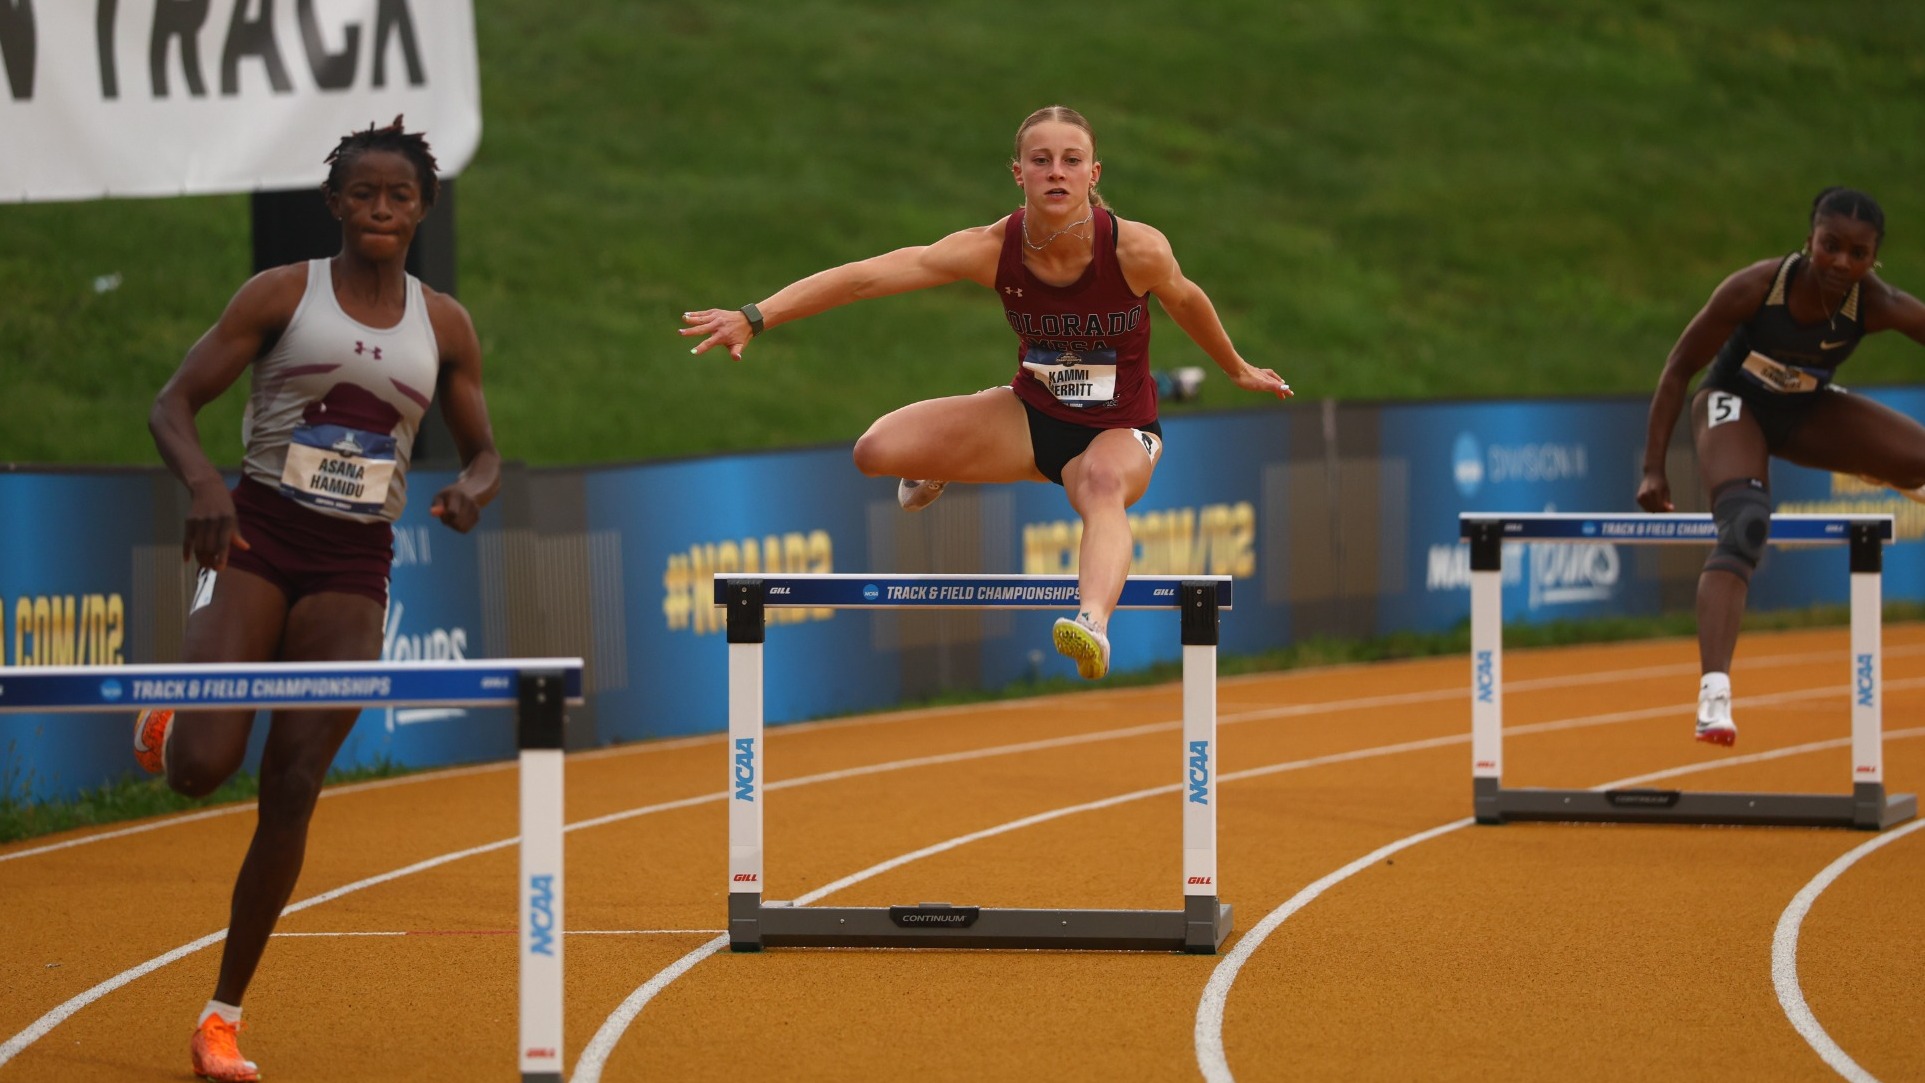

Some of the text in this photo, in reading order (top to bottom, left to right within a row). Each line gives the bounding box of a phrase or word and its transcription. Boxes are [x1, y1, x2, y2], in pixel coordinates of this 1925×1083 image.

[1048, 369, 1089, 383] KAMMI
[1715, 396, 1733, 422] 5
[318, 458, 365, 480] ASANA
[310, 474, 365, 498] HAMIDU
[769, 587, 791, 595] GILL
[887, 586, 1081, 600] TRACK & FIELD CHAMPIONSHIPS
[1153, 588, 1175, 596] GILL
[132, 680, 184, 699] TRACK
[203, 679, 249, 698] FIELD
[252, 676, 391, 697] CHAMPIONSHIPS
[1477, 650, 1493, 703] NCAA
[1857, 654, 1873, 707] NCAA
[735, 738, 754, 802] NCAA
[1189, 741, 1208, 805] NCAA
[733, 874, 757, 882] GILL
[1187, 877, 1212, 885] GILL
[529, 875, 554, 957] NCAA
